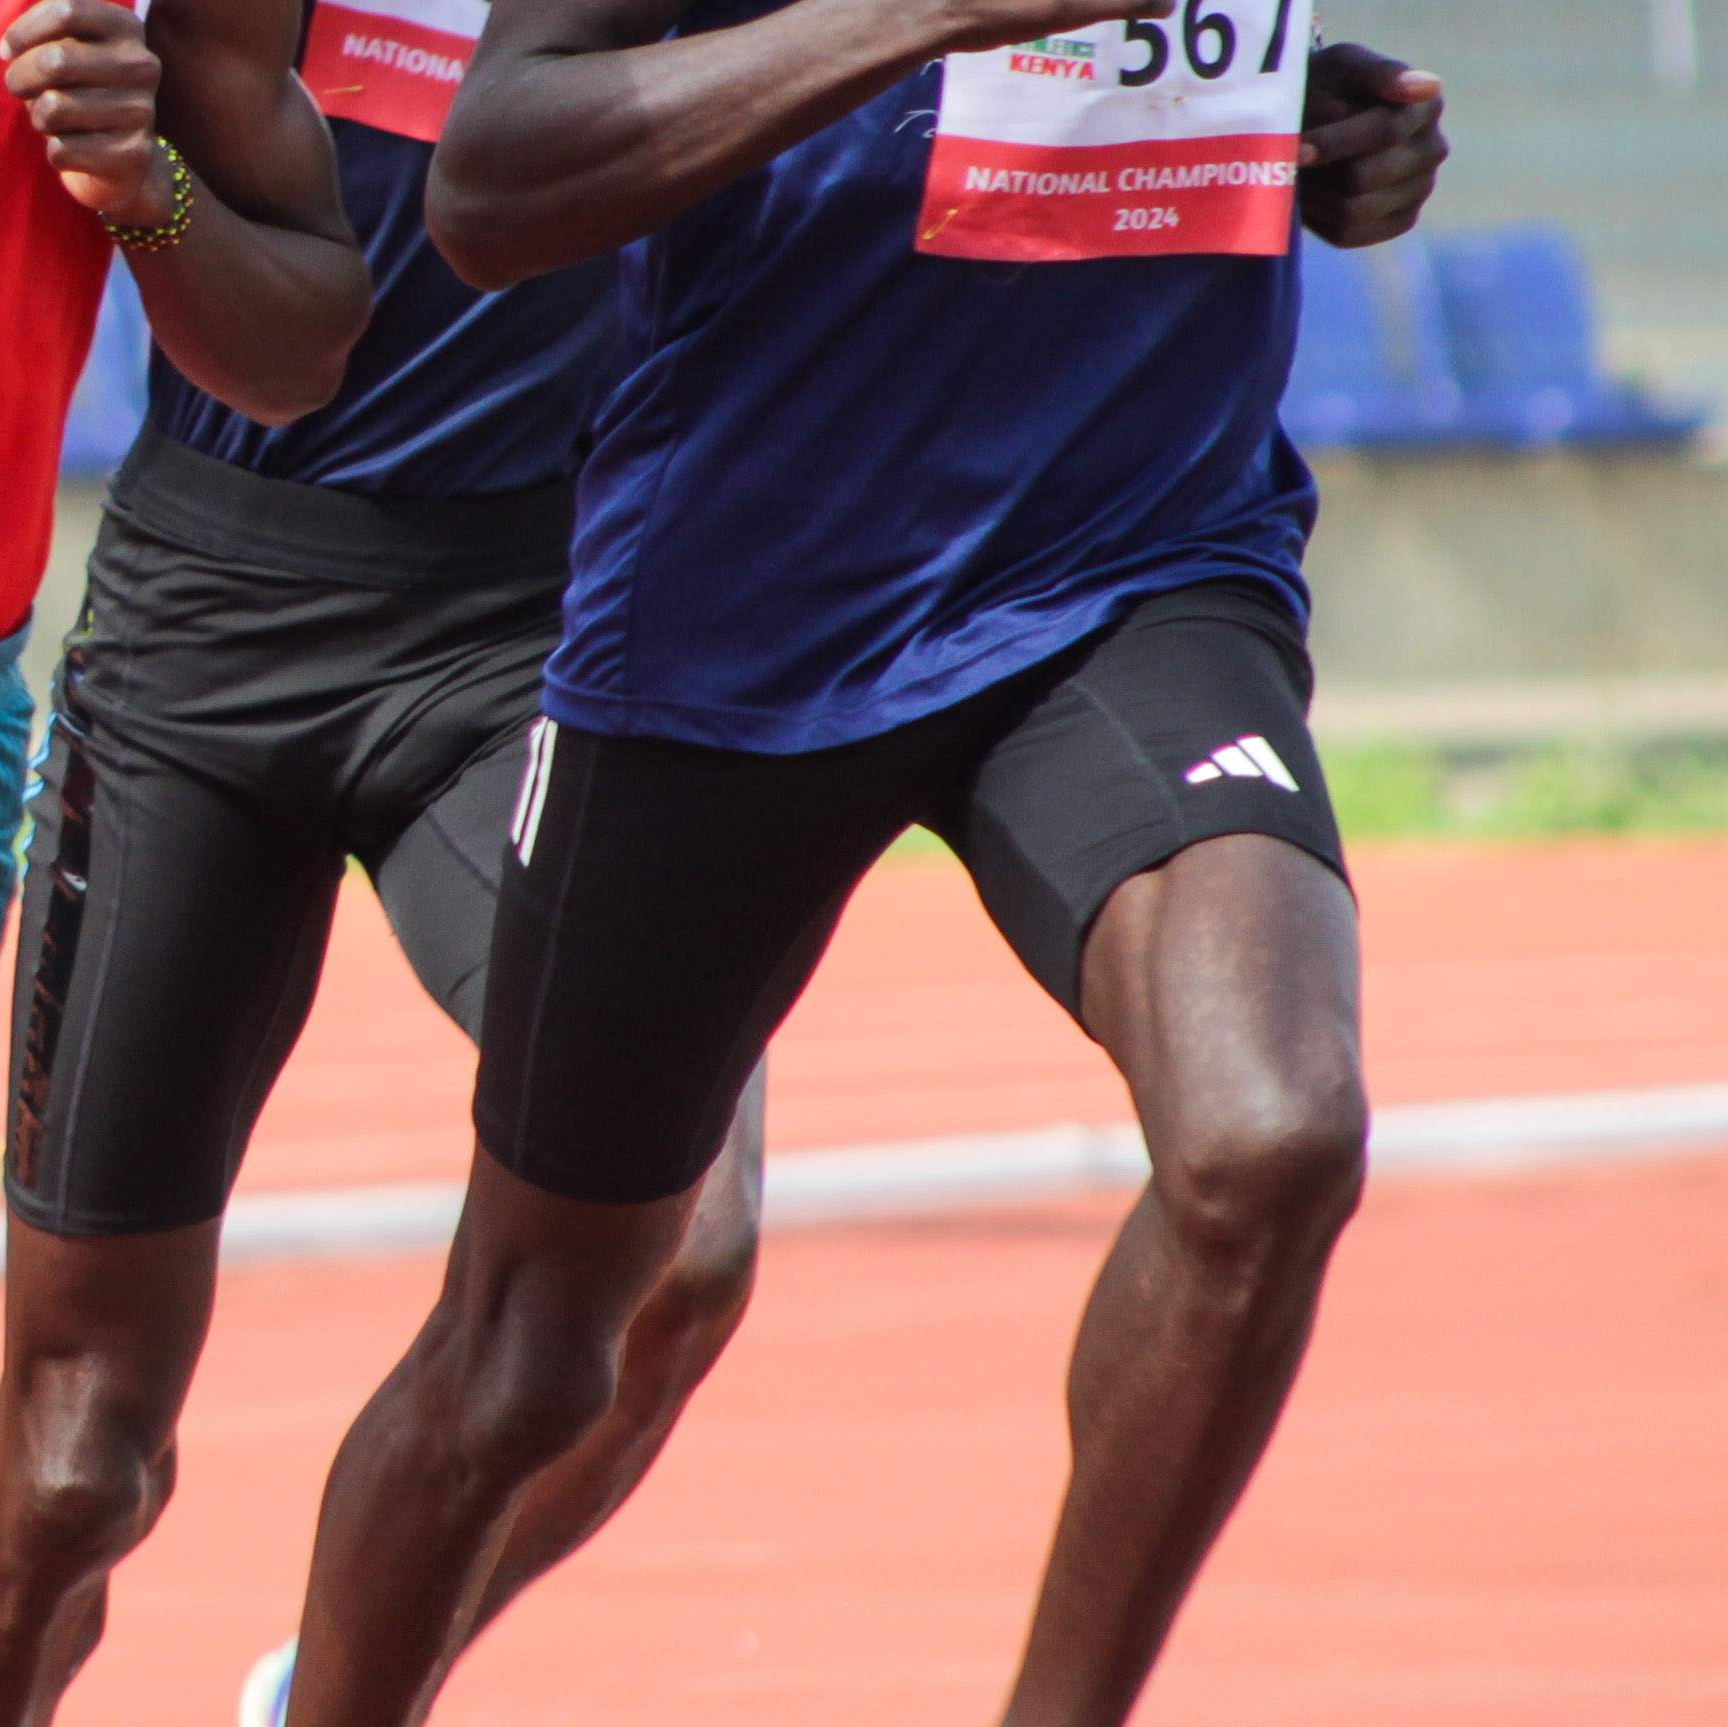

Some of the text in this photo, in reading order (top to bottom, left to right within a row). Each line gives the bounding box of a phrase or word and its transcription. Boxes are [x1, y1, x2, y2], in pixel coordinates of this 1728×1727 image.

[1008, 53, 1095, 81] KENYA
[964, 166, 1111, 196] NATIONAL
[1113, 207, 1180, 232] 2024
